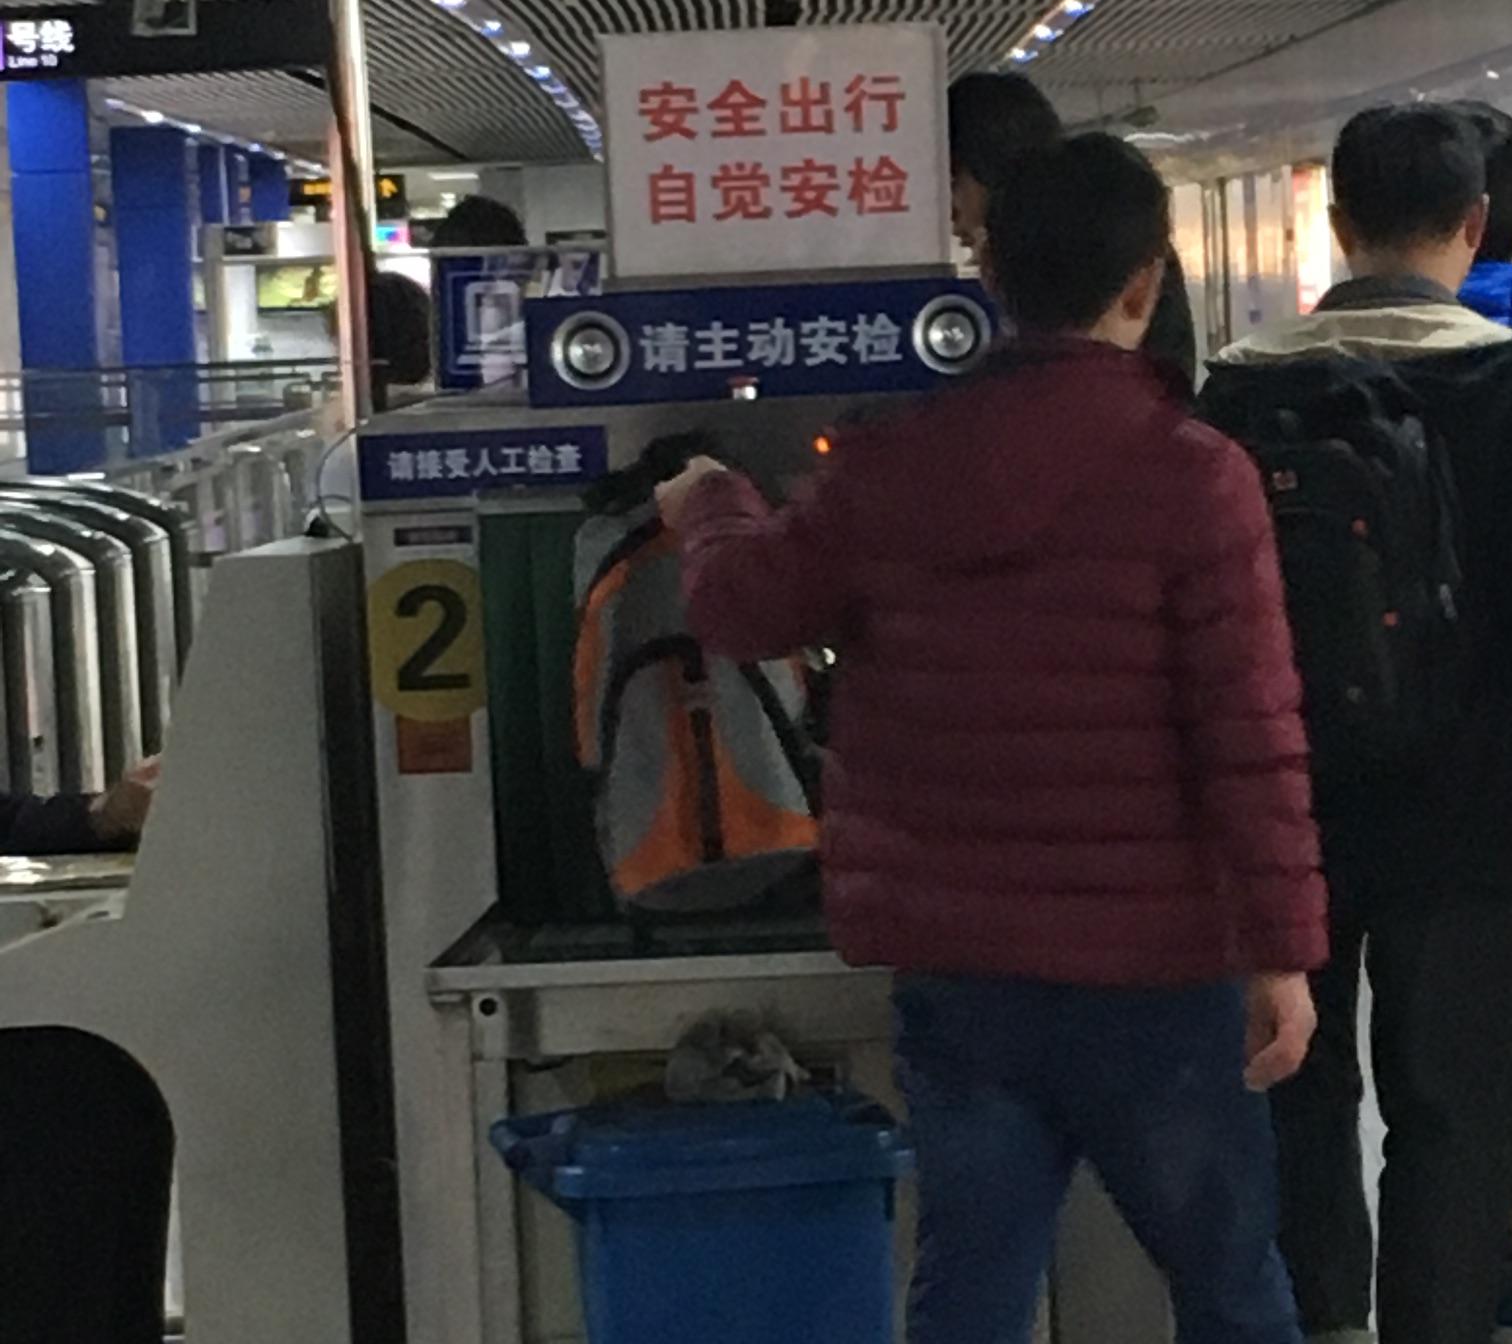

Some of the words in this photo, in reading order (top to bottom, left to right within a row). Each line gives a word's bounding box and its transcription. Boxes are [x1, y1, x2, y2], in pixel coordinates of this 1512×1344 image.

[638, 74, 906, 143] 安全出行
[648, 156, 910, 225] 自觉安检
[640, 313, 903, 373] 请主动安检
[387, 444, 583, 481] 请接受人工检查
[394, 585, 471, 692] 2
